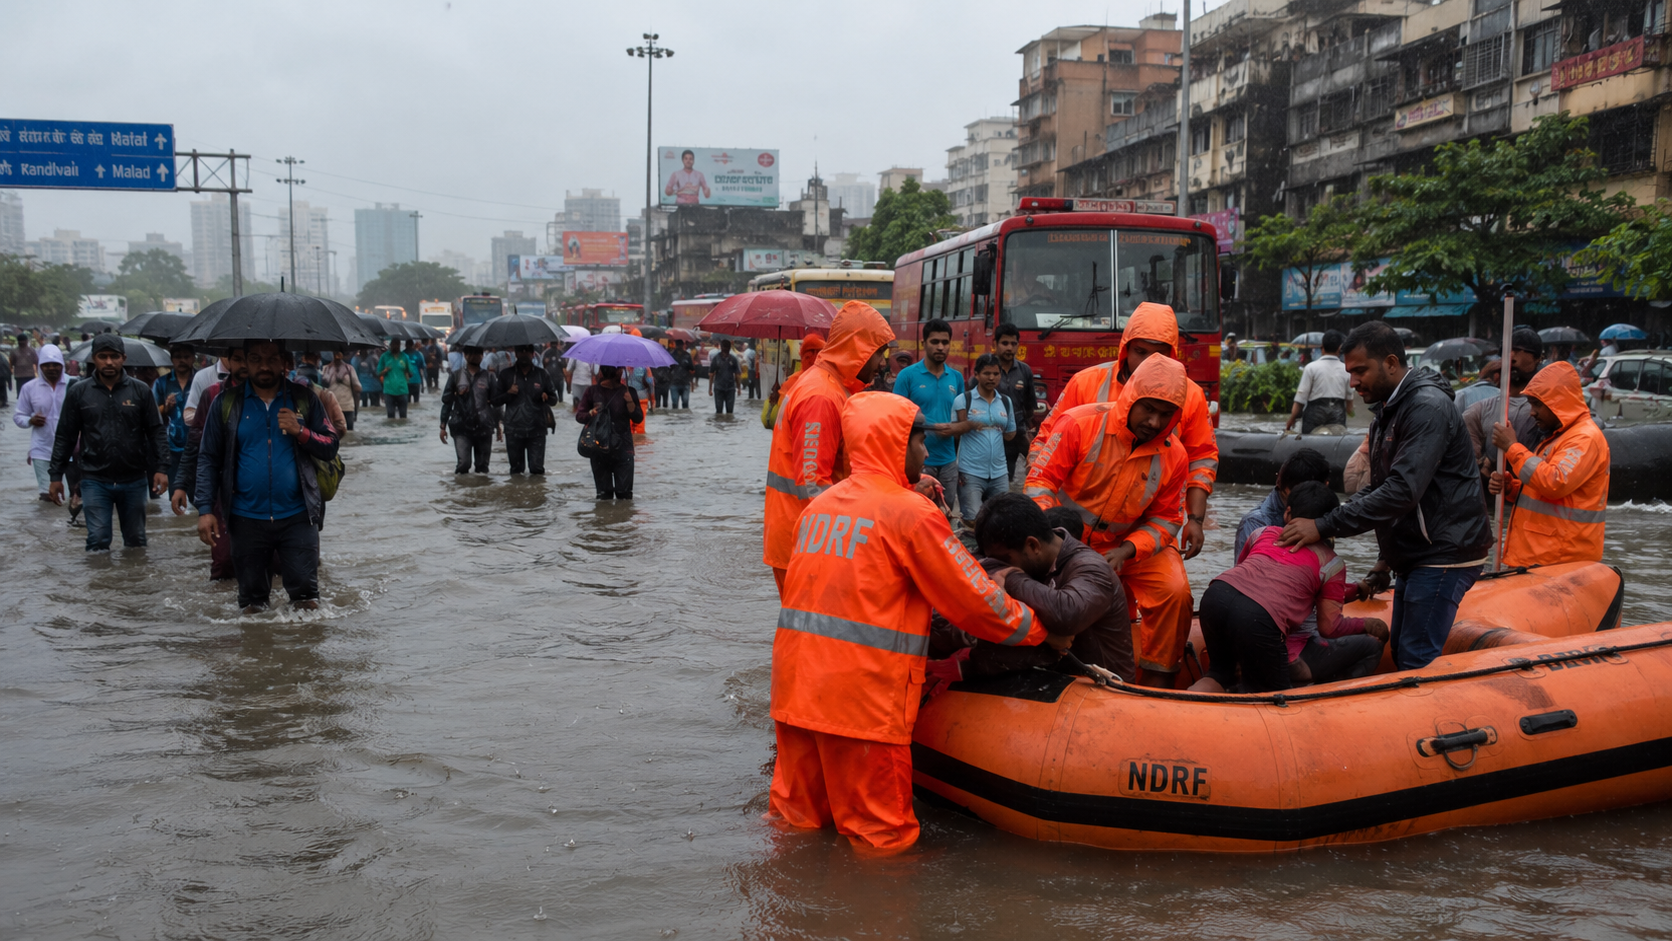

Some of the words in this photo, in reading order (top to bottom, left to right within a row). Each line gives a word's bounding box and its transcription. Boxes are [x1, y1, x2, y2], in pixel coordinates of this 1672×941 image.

[112, 164, 151, 179] Malad
[794, 513, 875, 560] NDRF
[1128, 761, 1207, 796] NDRF
